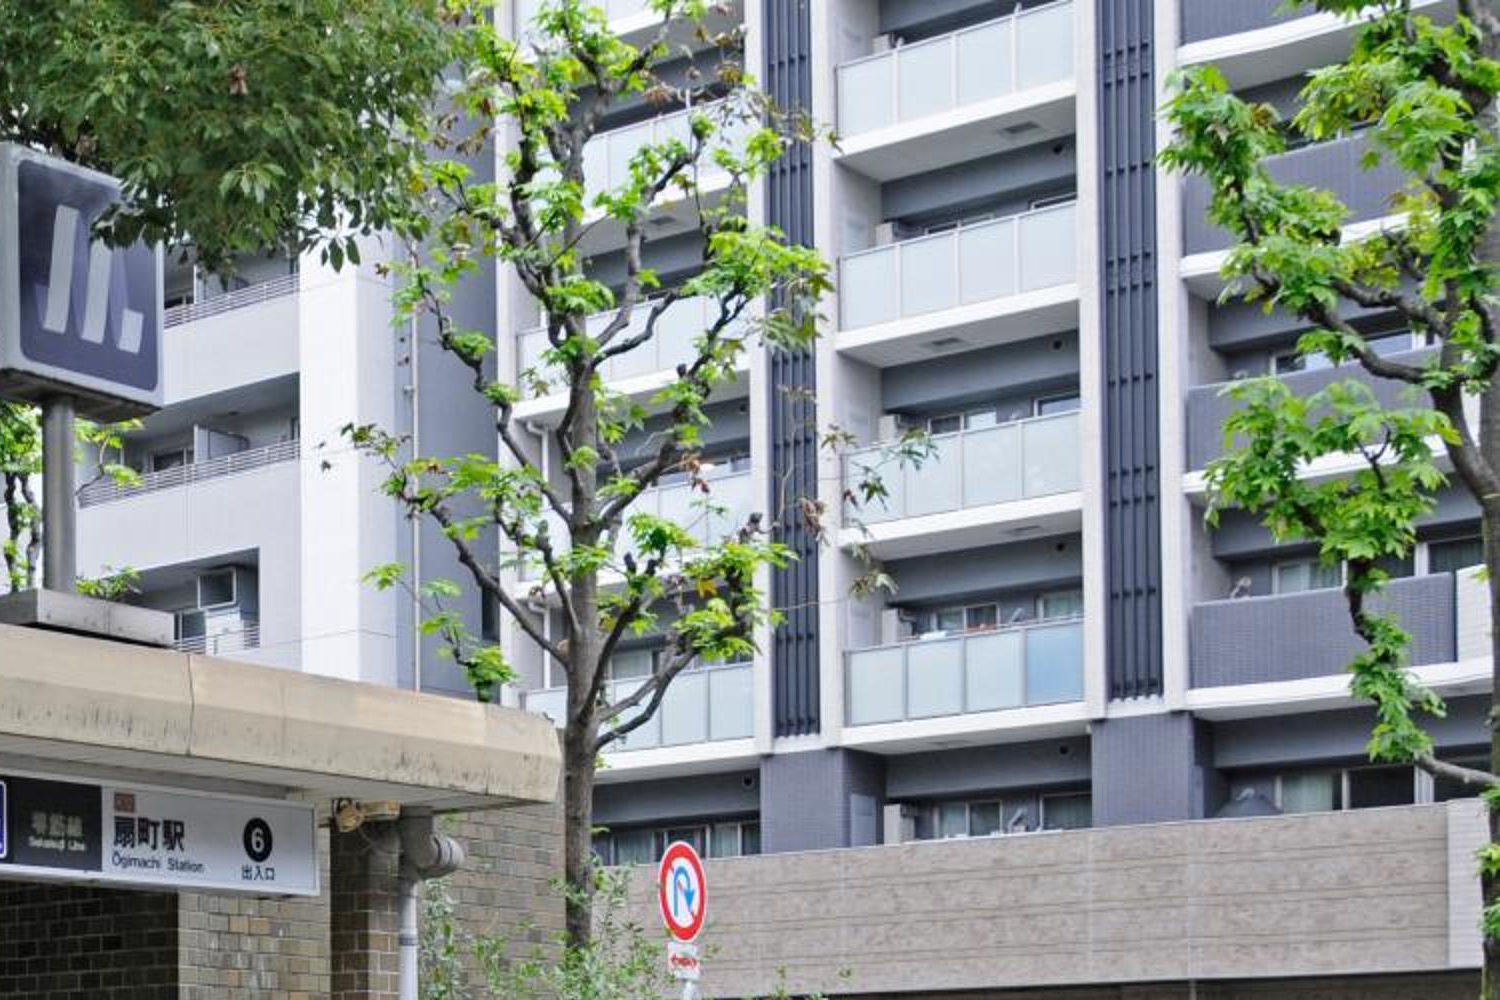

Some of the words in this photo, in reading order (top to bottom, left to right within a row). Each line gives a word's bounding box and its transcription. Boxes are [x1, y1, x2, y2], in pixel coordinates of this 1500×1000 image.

[113, 815, 185, 851] 扇町駅
[251, 827, 265, 852] 6
[167, 857, 204, 873] Station
[241, 864, 276, 881] 出入口
